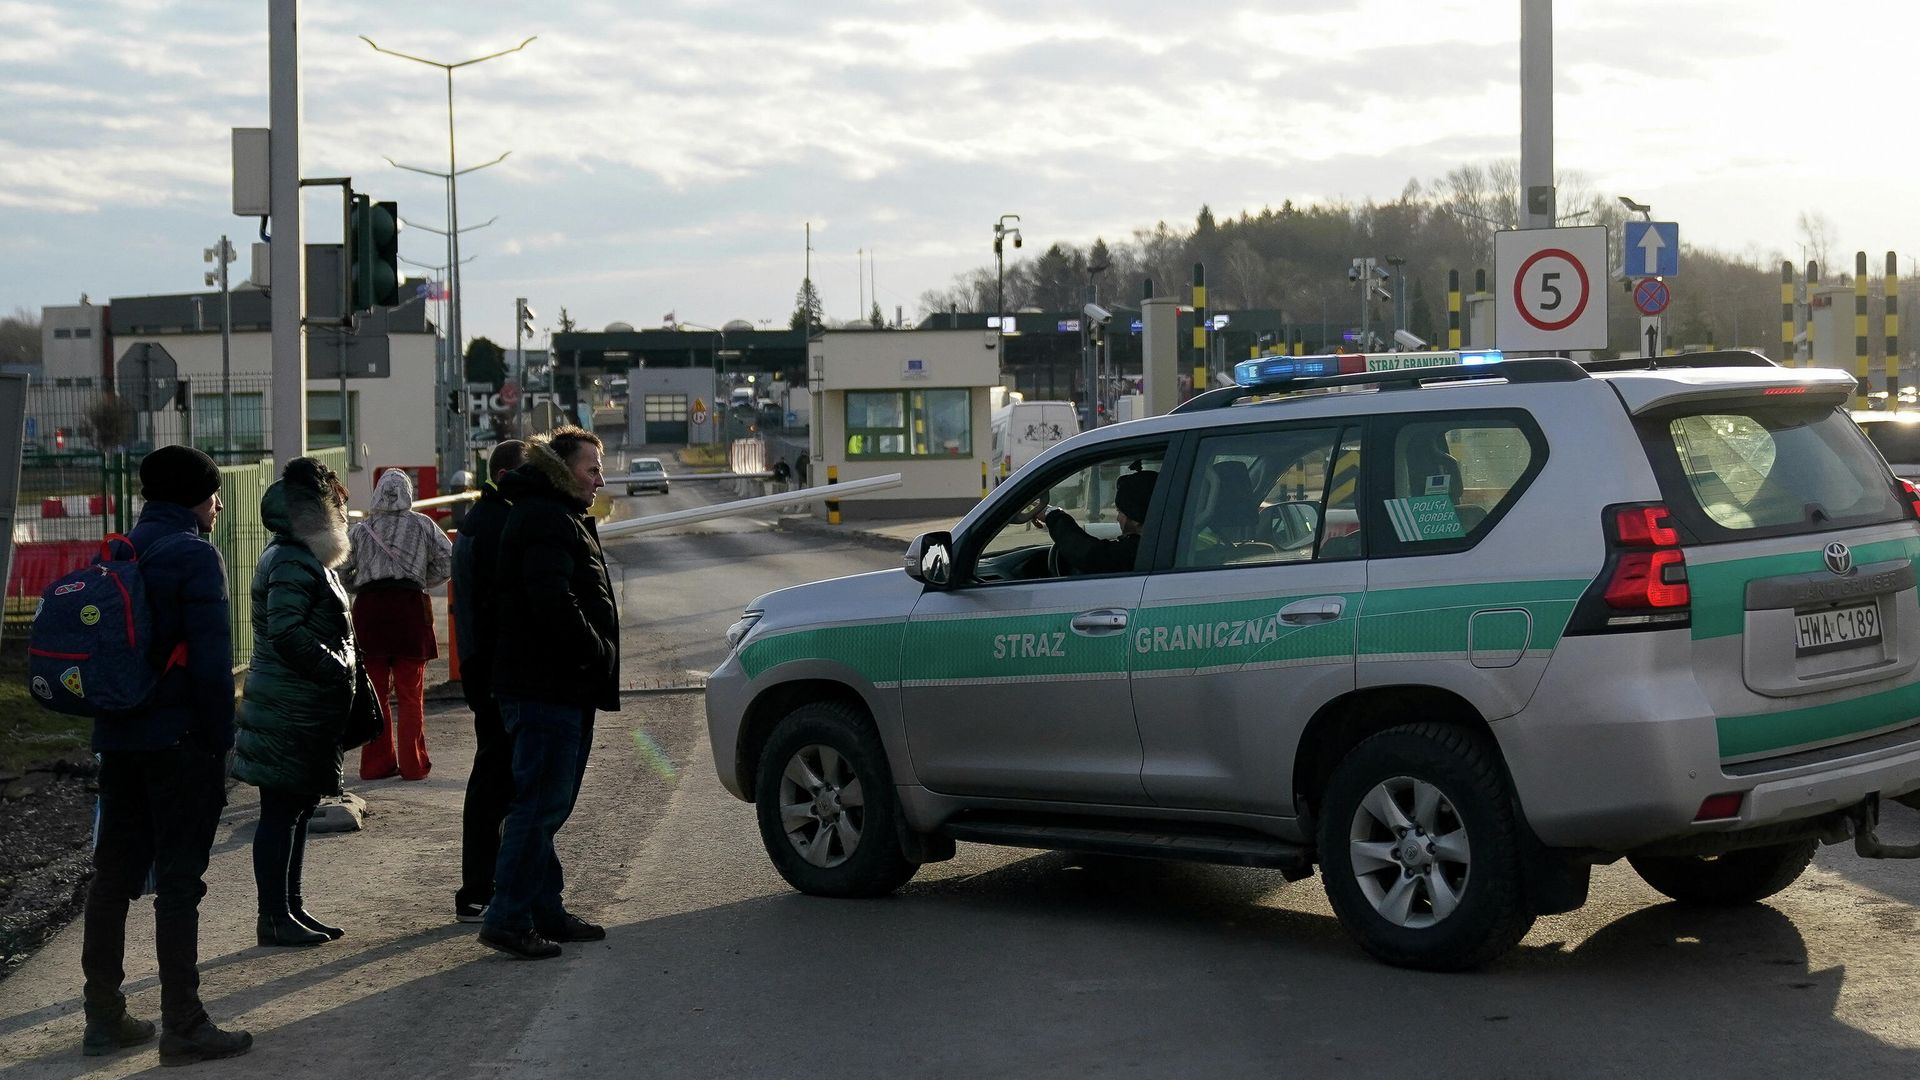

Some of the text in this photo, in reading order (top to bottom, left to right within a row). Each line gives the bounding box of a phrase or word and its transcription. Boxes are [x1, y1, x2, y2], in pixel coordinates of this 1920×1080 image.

[1540, 272, 1561, 310] 5
[1369, 355, 1457, 372] STRAŻ GRANICZNA
[1412, 500, 1448, 513] POLISH
[1418, 511, 1455, 523] BORDER
[1423, 523, 1460, 534] GUARD
[1134, 617, 1278, 654] GRANICZNA
[1798, 608, 1875, 647] HWA C189
